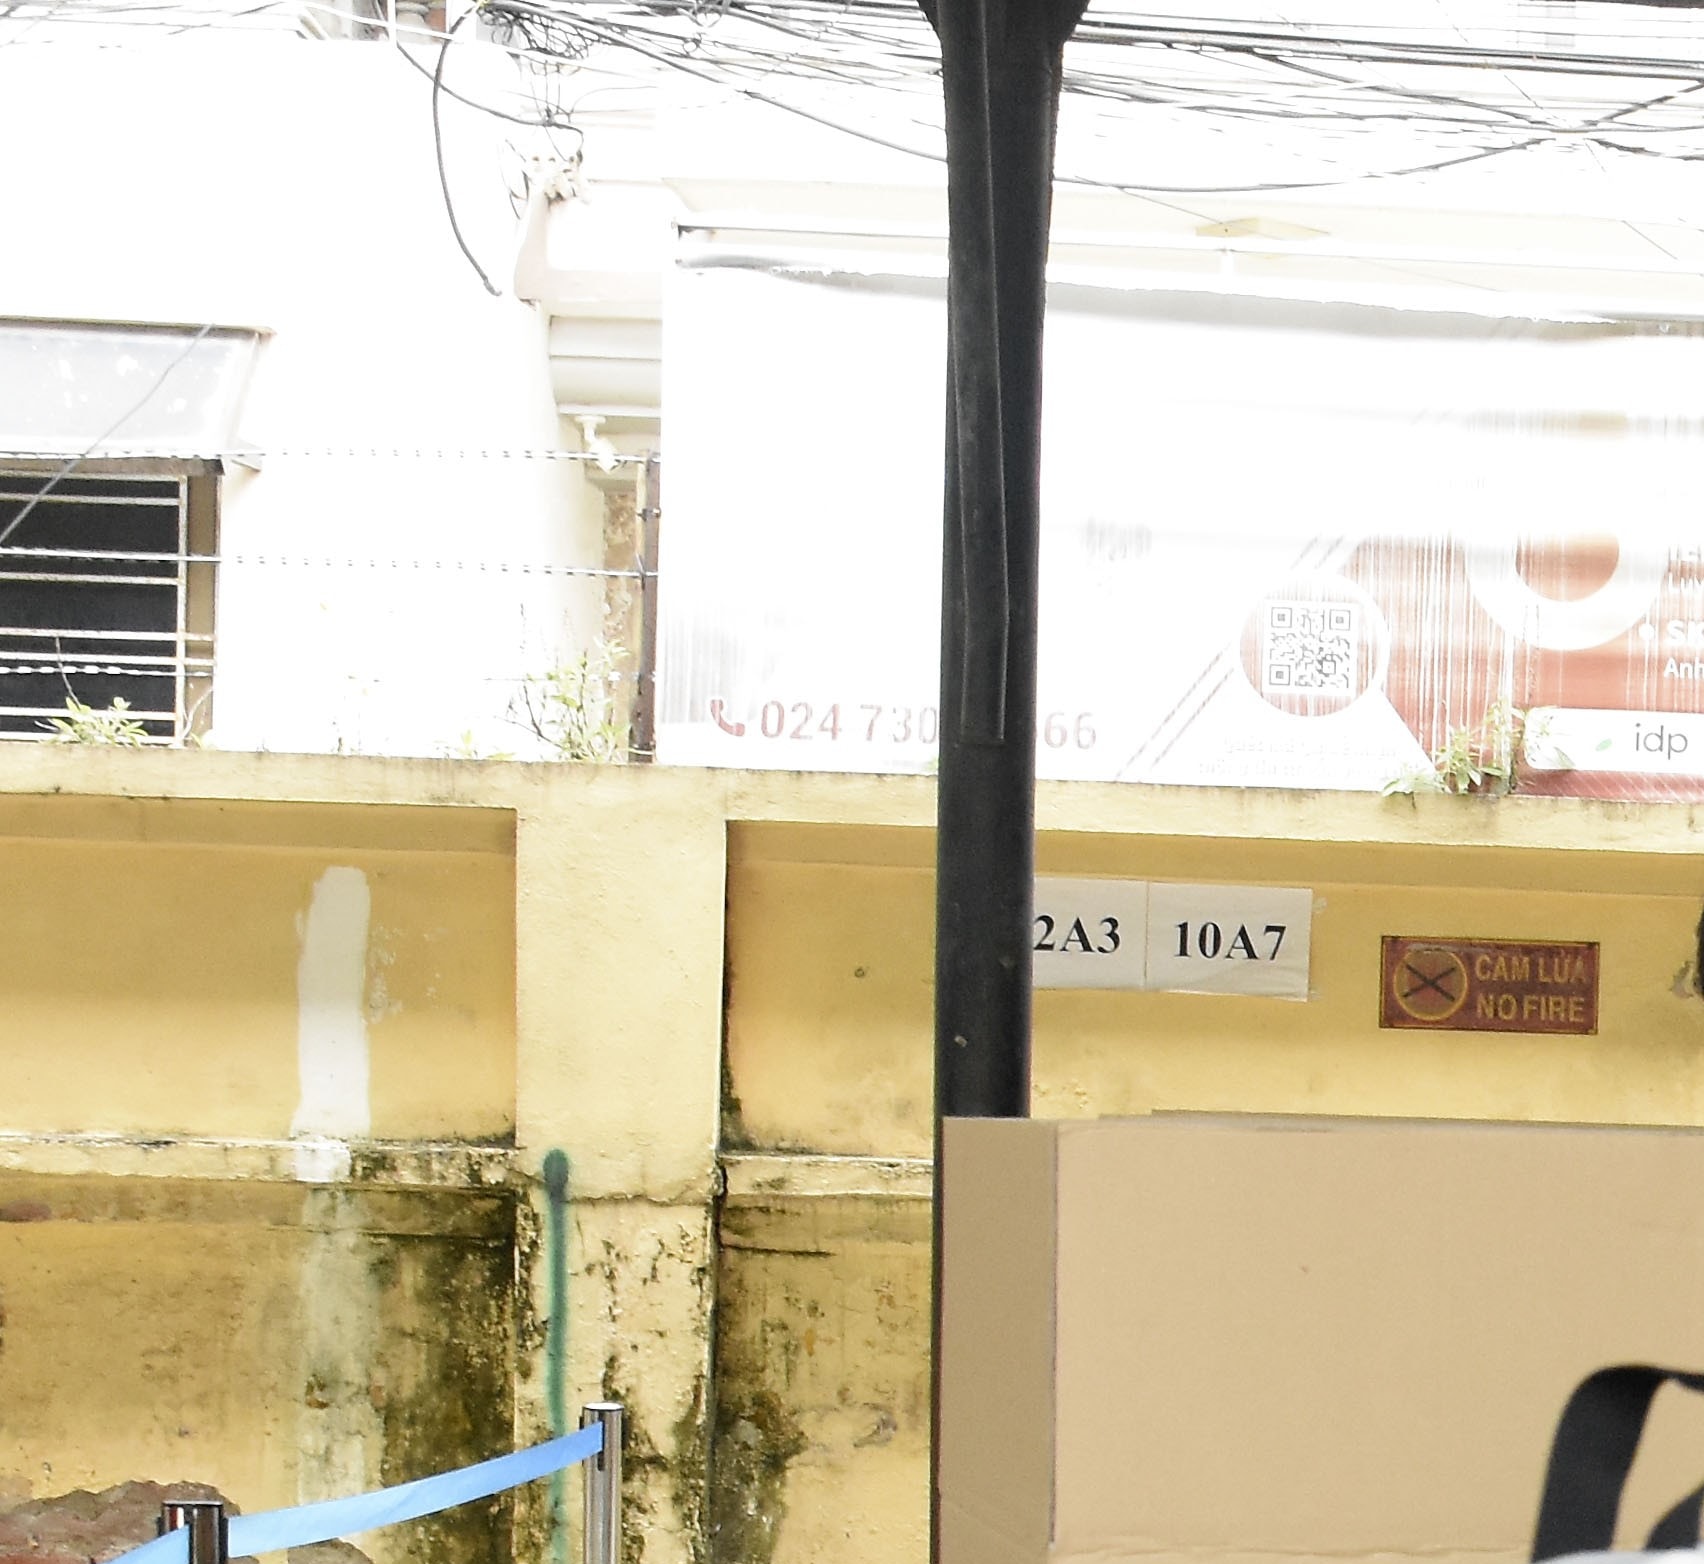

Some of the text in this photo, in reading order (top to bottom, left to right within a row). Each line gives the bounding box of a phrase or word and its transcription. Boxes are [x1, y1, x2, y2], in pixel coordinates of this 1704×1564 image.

[761, 700, 843, 740] 024
[1635, 722, 1688, 759] idp
[1174, 921, 1287, 960] 10A7
[1476, 992, 1584, 1023] NO FIRE
